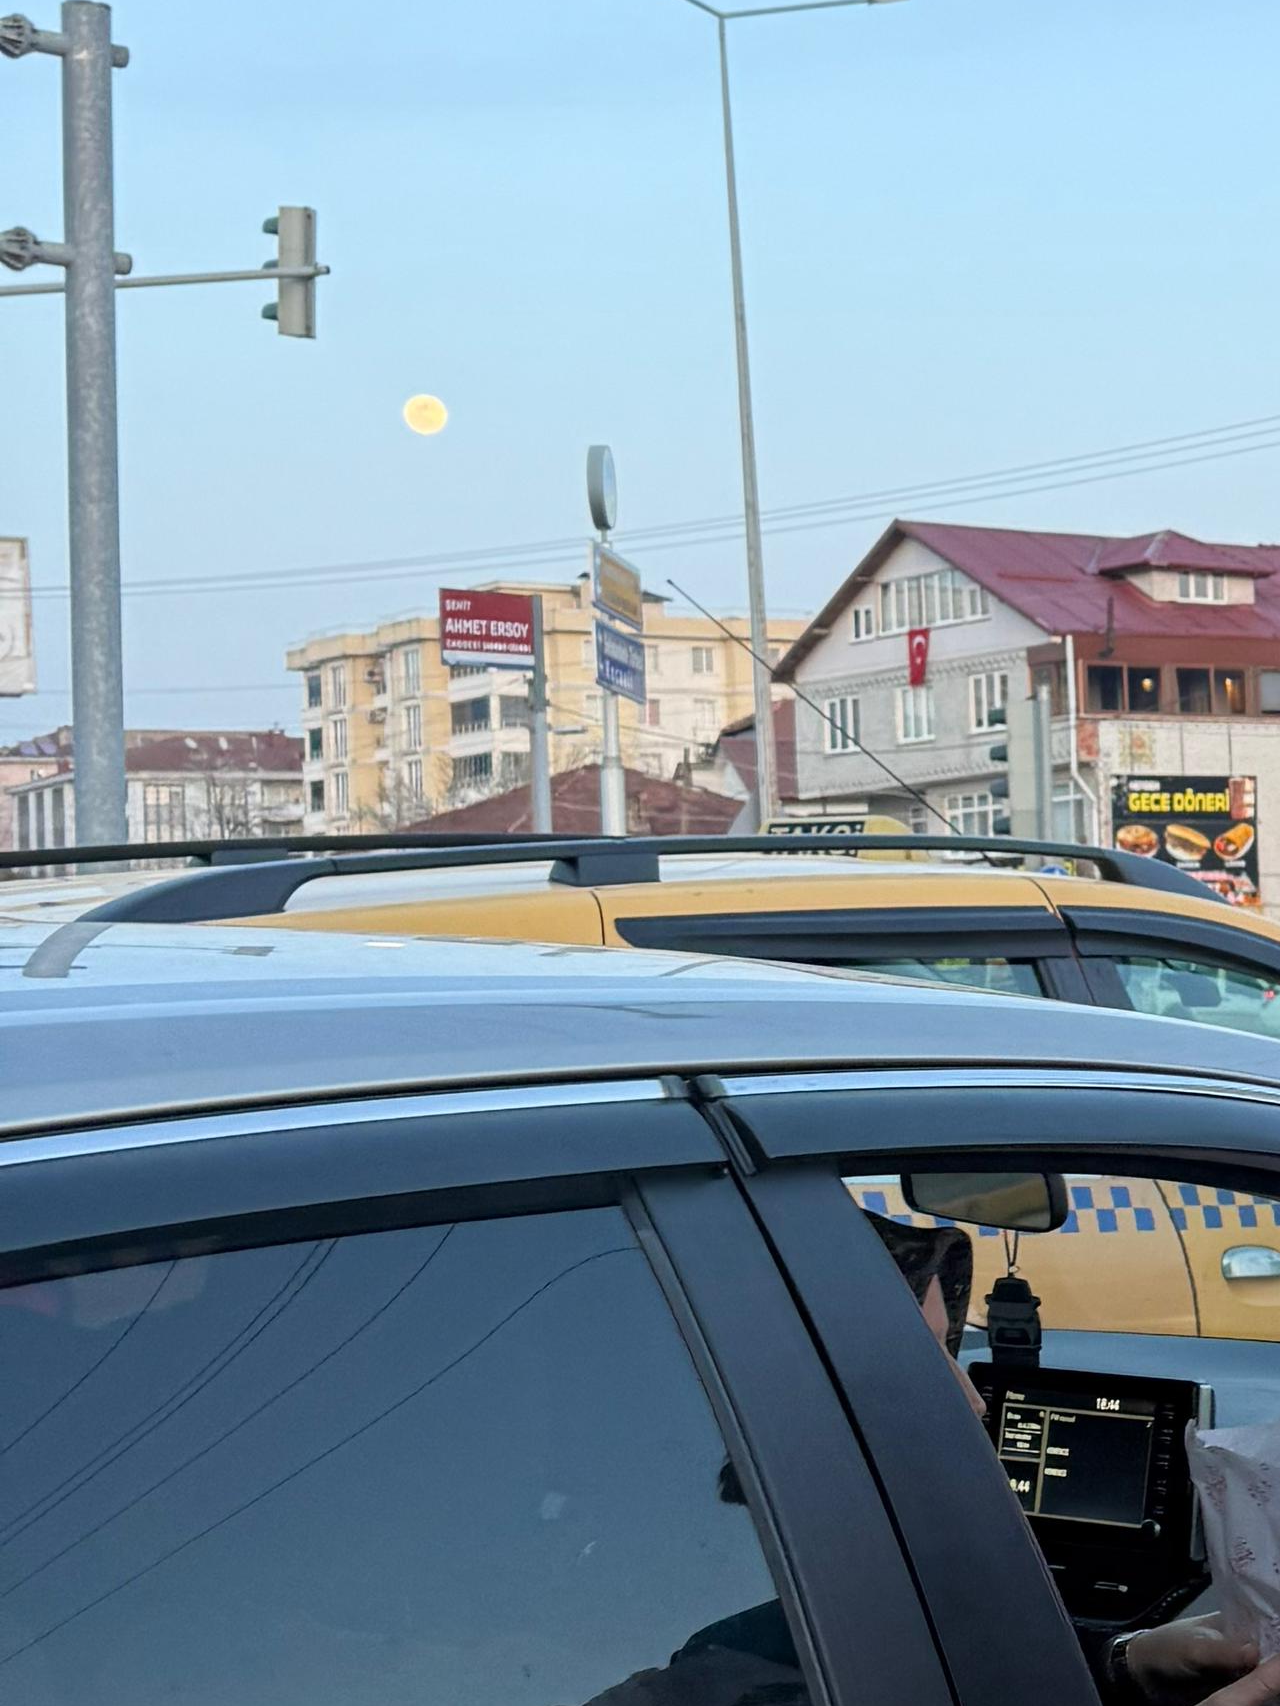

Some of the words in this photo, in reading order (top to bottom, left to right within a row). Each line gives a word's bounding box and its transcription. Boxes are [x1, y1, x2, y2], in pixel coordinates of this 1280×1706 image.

[445, 617, 487, 636] AHMET
[490, 620, 529, 639] ERSOY
[1128, 793, 1171, 812] GECE
